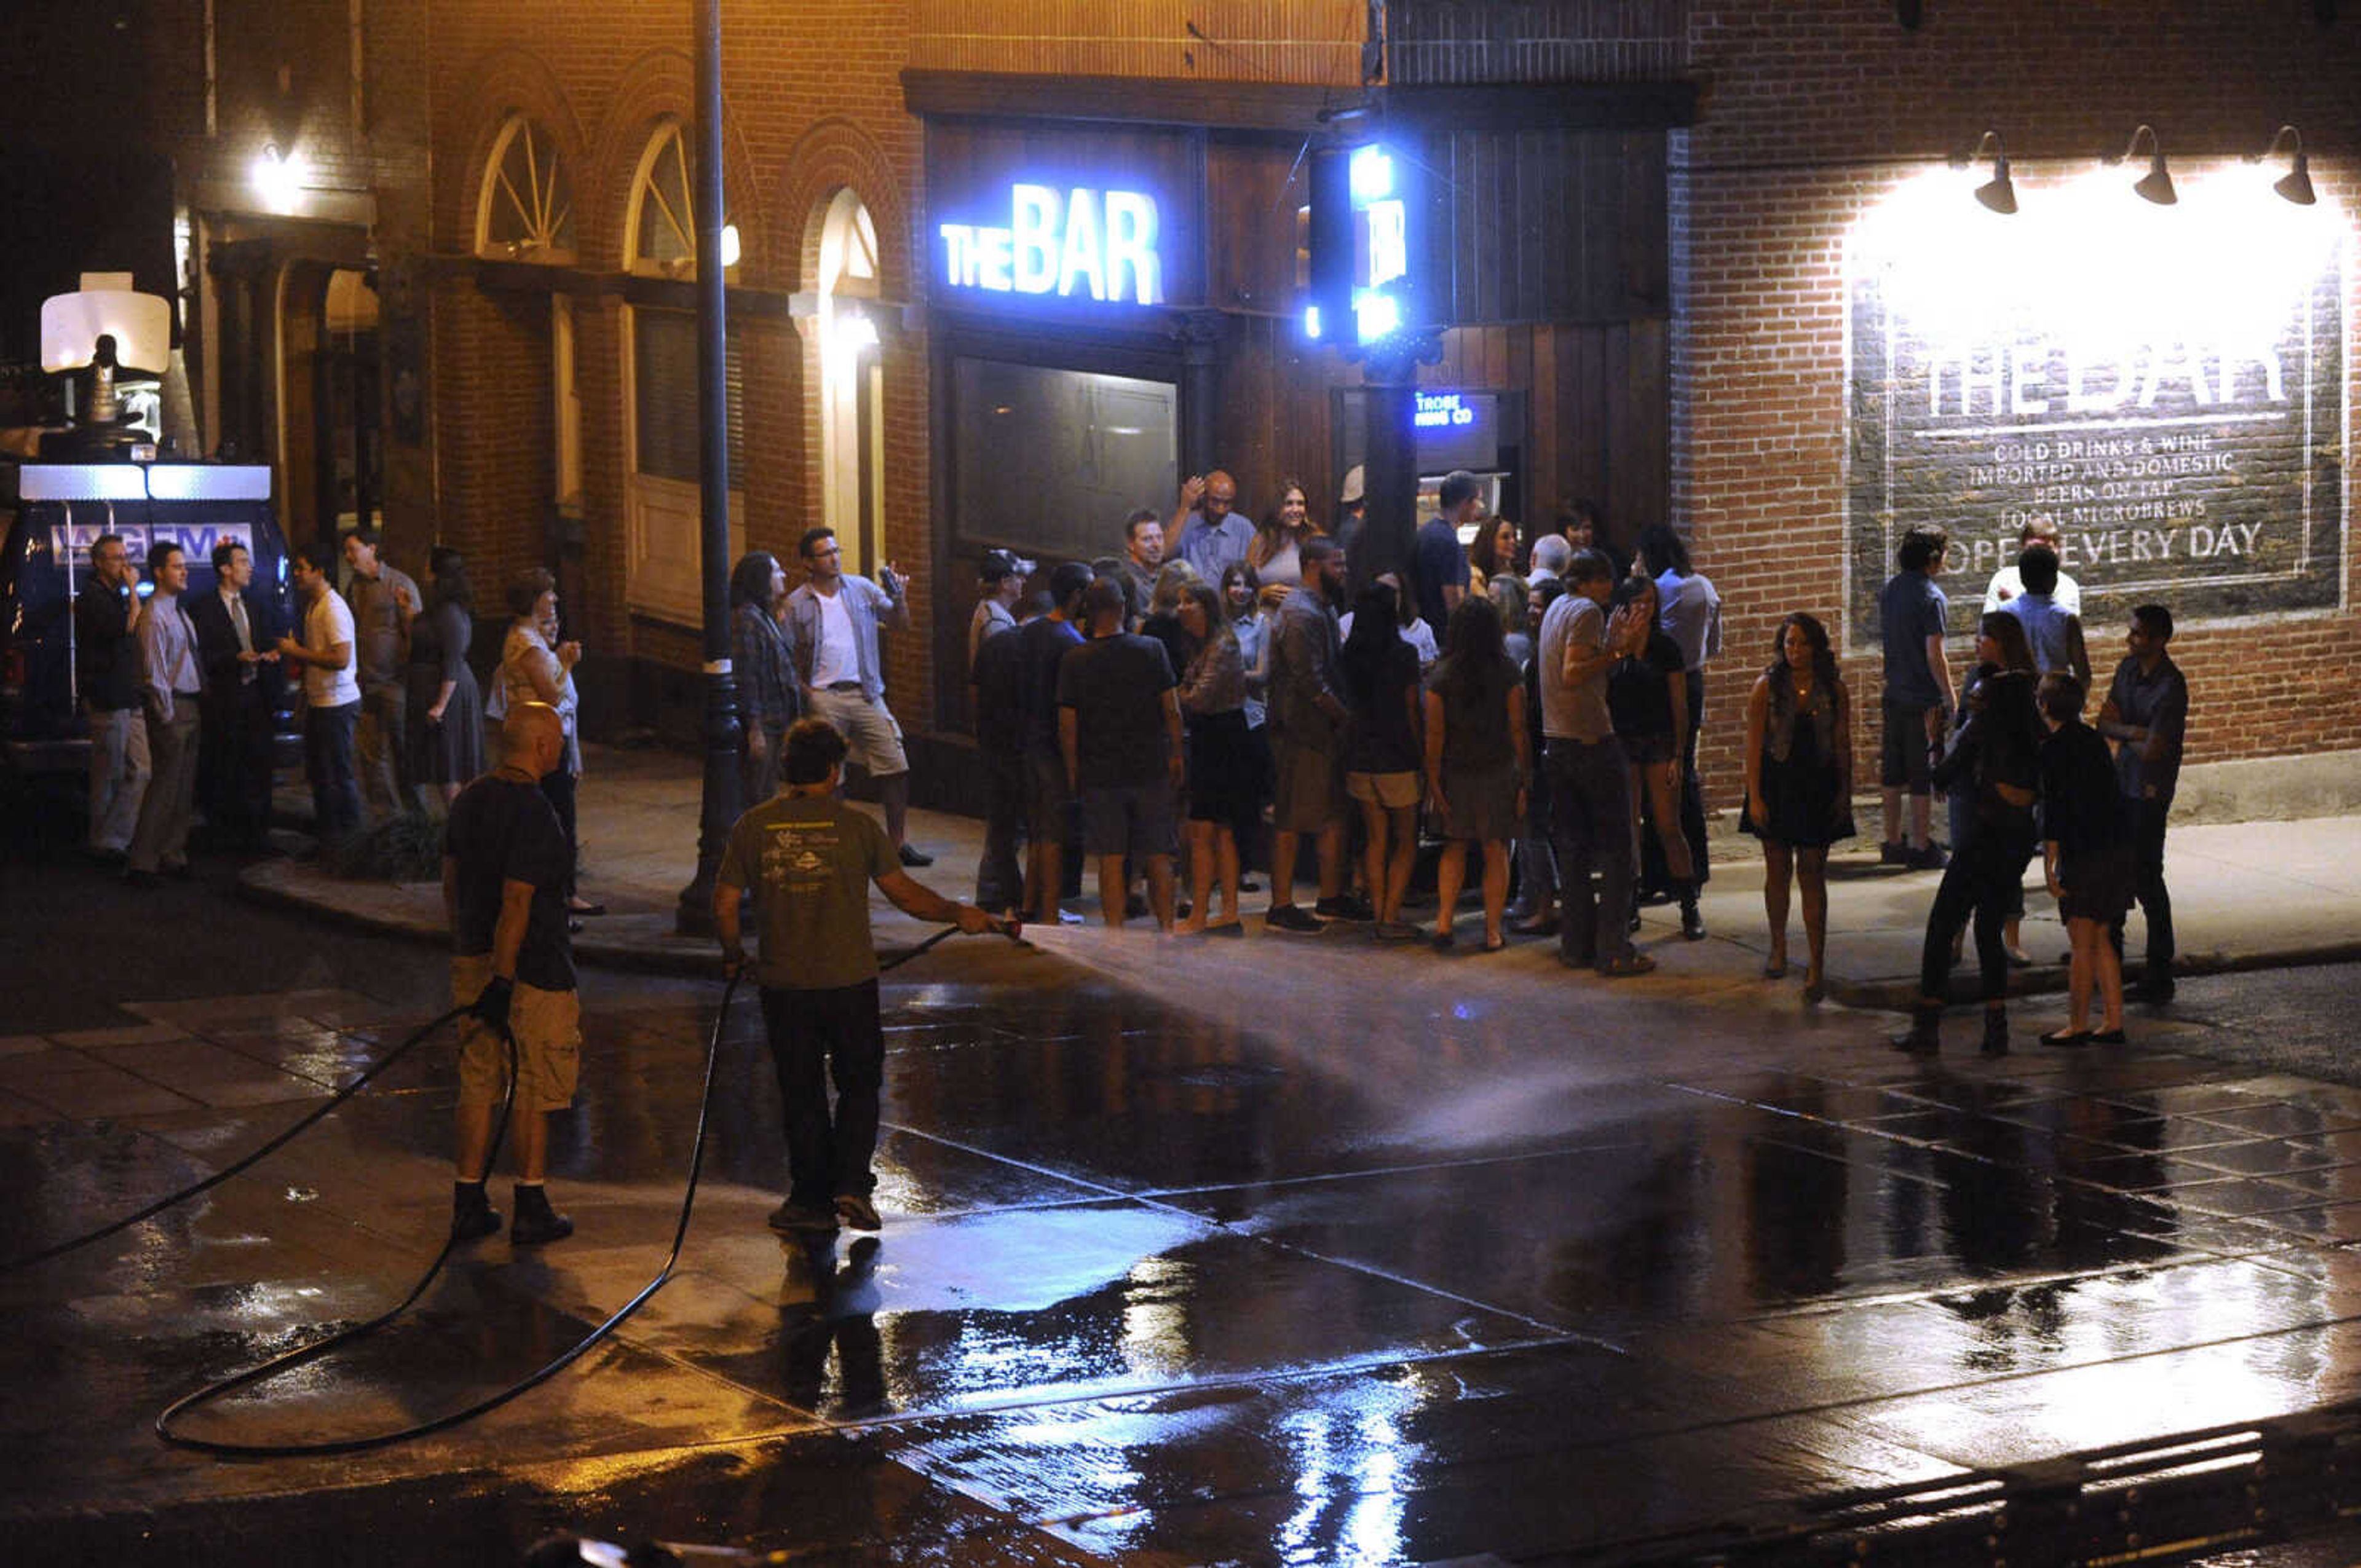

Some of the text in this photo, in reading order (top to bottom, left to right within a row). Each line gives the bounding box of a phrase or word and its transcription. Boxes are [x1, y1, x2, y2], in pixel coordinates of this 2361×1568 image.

[940, 184, 1165, 305] THE BAR
[1995, 434, 2212, 462] COLD DRINKS & WINE
[1969, 455, 2233, 486] IMPORTED AND DOMESTIC
[2035, 481, 2175, 503] BEERS ON TAP
[2001, 498, 2206, 529] LOCAL MICROBREWS
[1940, 521, 2263, 574] OPE EVERY DAY
